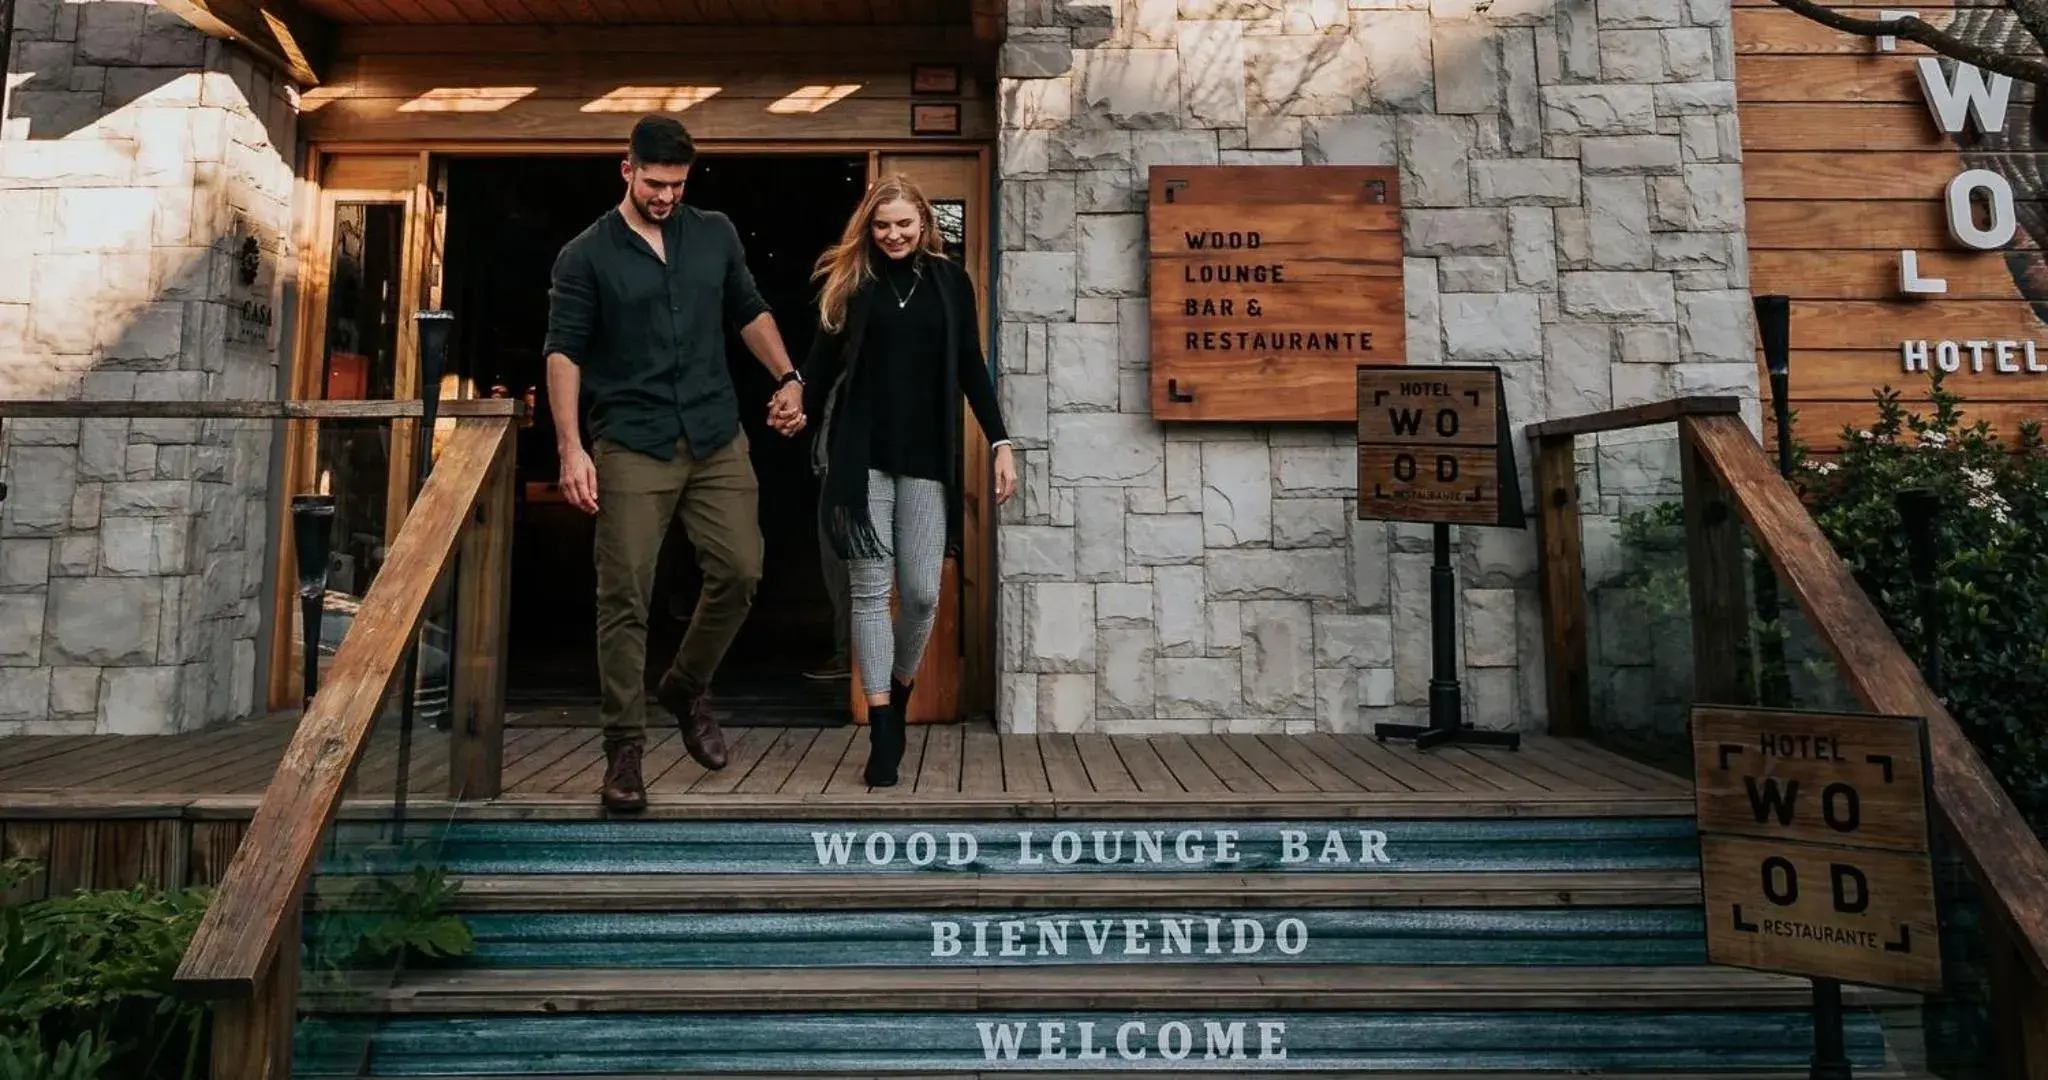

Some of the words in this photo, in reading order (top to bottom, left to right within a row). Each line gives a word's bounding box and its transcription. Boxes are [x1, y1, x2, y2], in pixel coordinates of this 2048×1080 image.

[1185, 232, 1260, 249] WOOD
[1185, 265, 1284, 283] LOUNGE
[1185, 299, 1233, 316] BAR
[1246, 299, 1262, 317] &
[1186, 332, 1373, 350] RESTAURANTE
[1902, 340, 2047, 372] HOTEL
[1400, 382, 1451, 397] HOTEL
[1760, 733, 1845, 761] HOTEL
[811, 831, 980, 866] WOOD
[1018, 830, 1241, 864] LOUNGE
[1280, 829, 1391, 863] BAR
[930, 918, 1309, 957] BIENVENIDO
[1763, 919, 1878, 949] RESTAURANTE
[976, 1021, 1289, 1062] WELCOME
